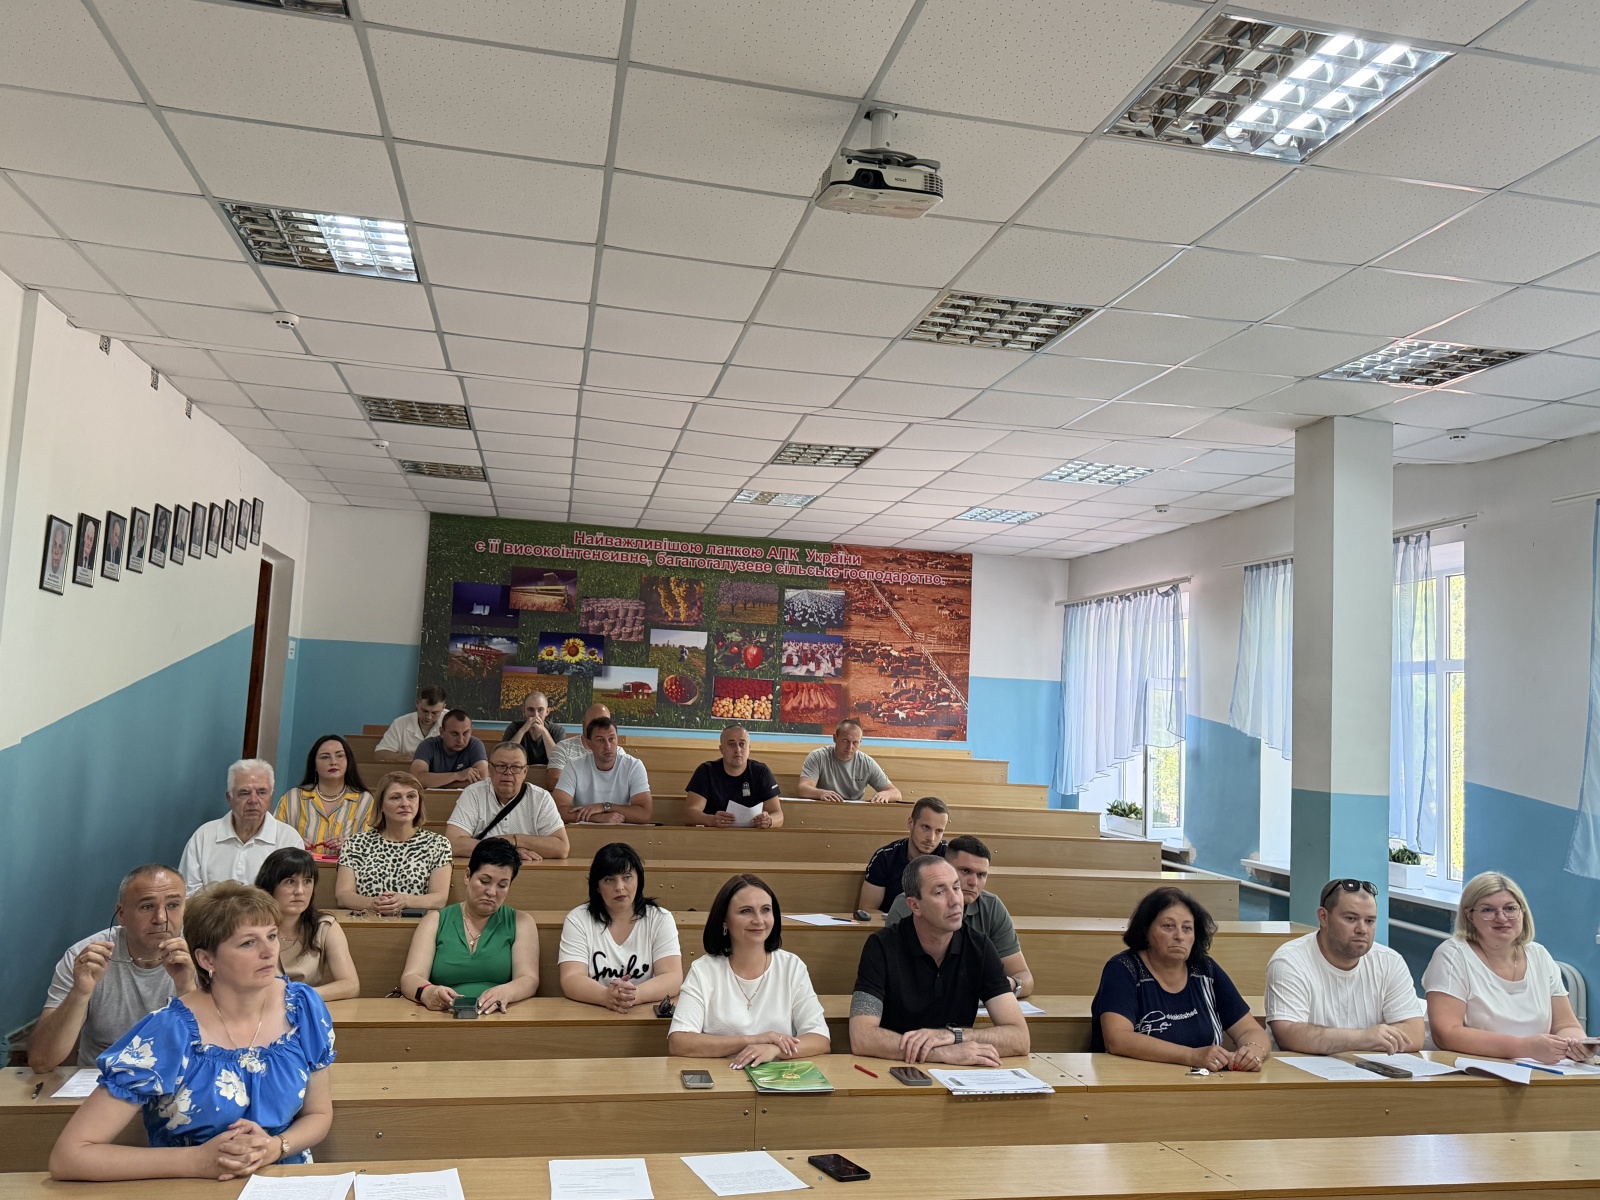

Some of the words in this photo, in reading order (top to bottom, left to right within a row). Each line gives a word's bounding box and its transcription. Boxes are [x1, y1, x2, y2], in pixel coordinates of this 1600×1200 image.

[488, 539, 501, 553] її
[503, 543, 653, 566] високоінтенсивне,
[656, 552, 772, 573] багатогалузеве
[775, 561, 840, 578] сільське
[841, 567, 946, 585] господарство.
[574, 531, 703, 554] Найважливішою
[706, 544, 764, 558] ланкою
[767, 546, 800, 561] АПК
[805, 548, 862, 566] України
[592, 951, 645, 981] Smile
